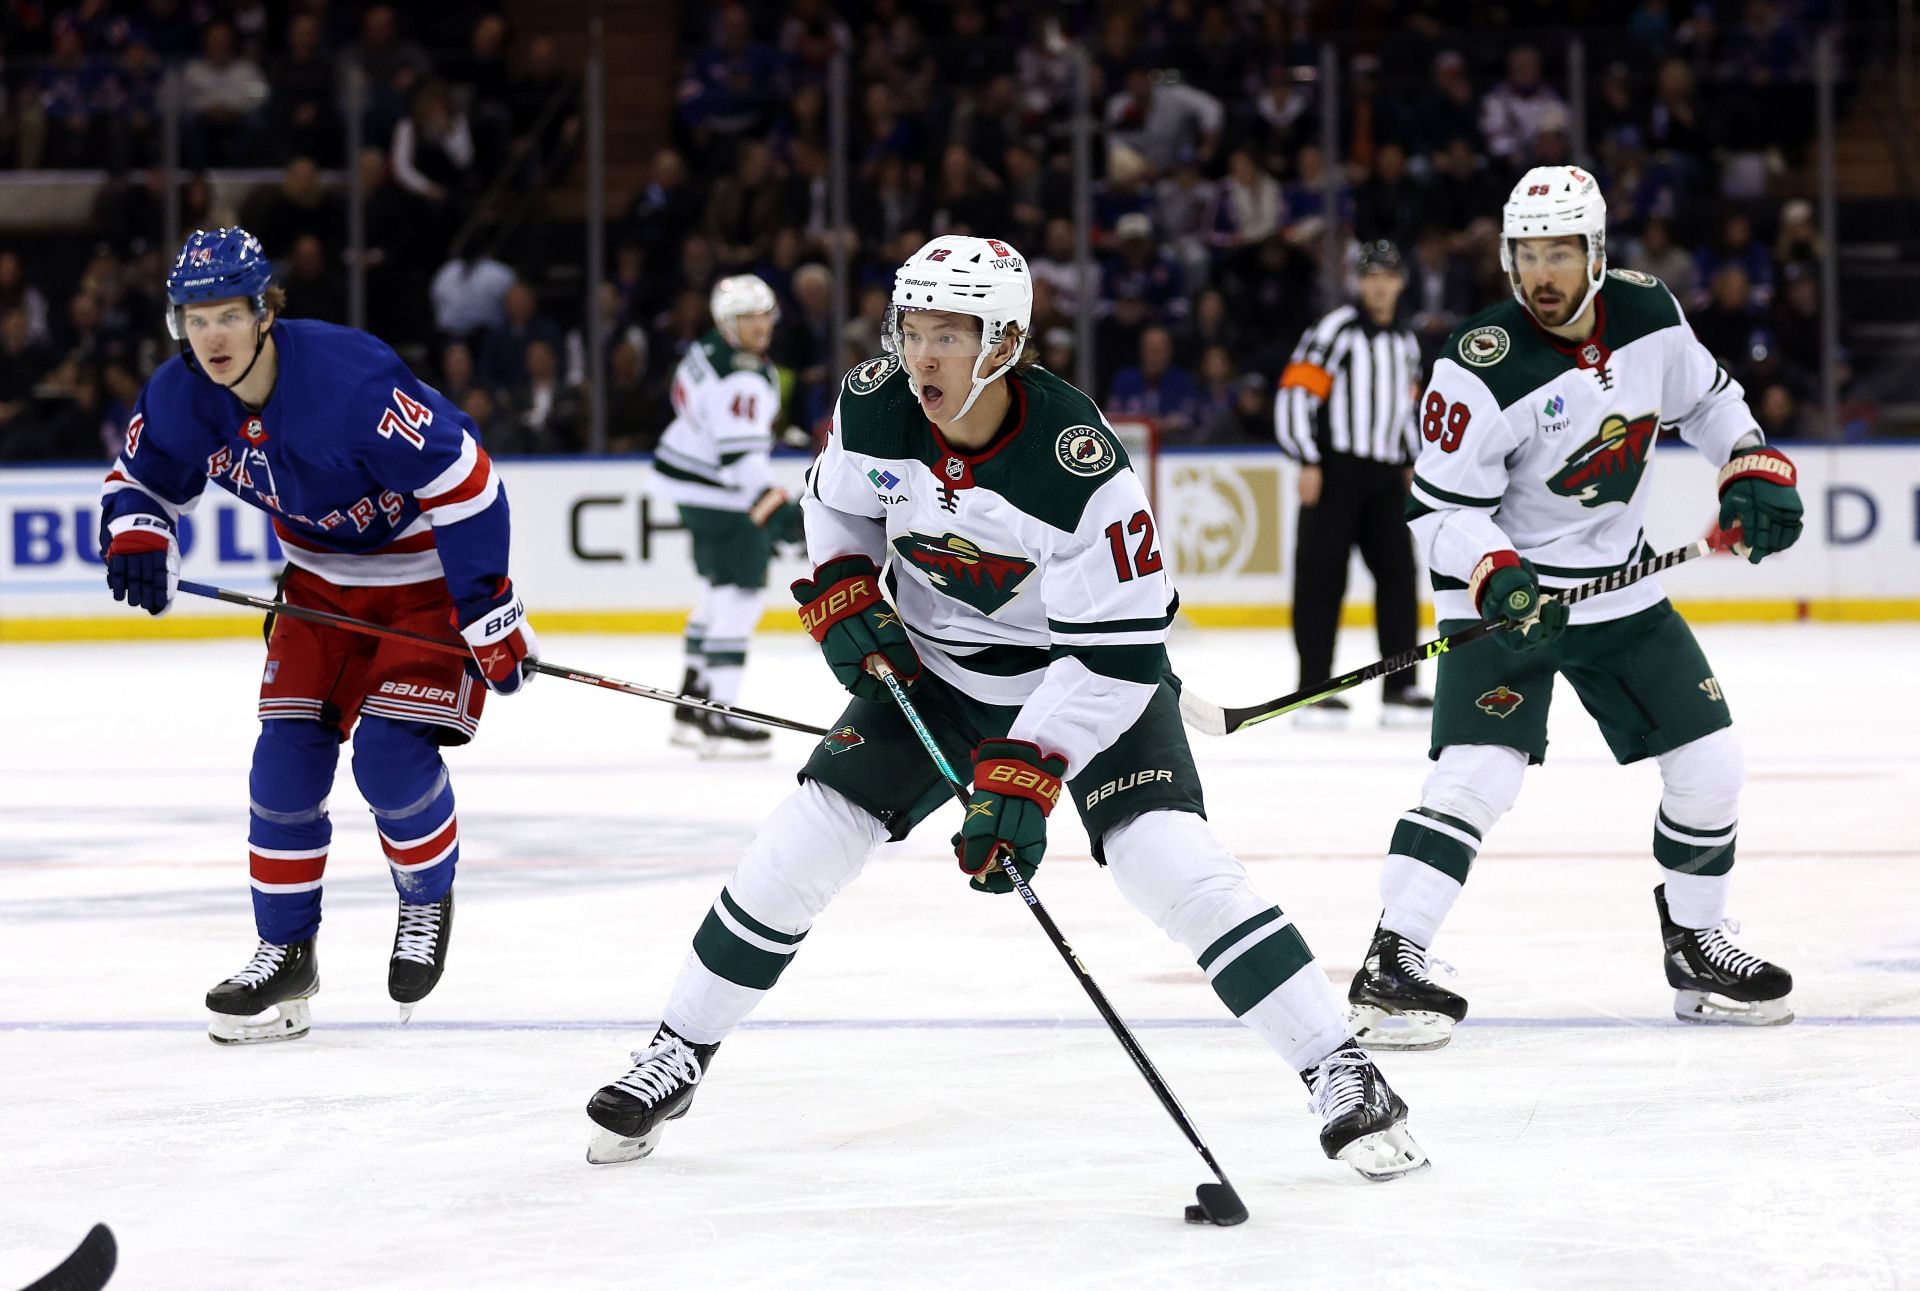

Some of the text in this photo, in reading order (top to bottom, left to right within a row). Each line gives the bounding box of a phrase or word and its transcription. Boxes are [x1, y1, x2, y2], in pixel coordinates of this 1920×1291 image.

[190, 247, 211, 264] 74
[925, 248, 952, 262] 12
[989, 257, 1022, 270] TOYOTA
[377, 387, 434, 451] 74
[1423, 390, 1472, 454] 89
[1091, 455, 1111, 471] WILD
[207, 446, 404, 535] RANERS
[875, 491, 909, 505] RIA
[1105, 509, 1164, 583] 12
[1426, 637, 1450, 659] LX
